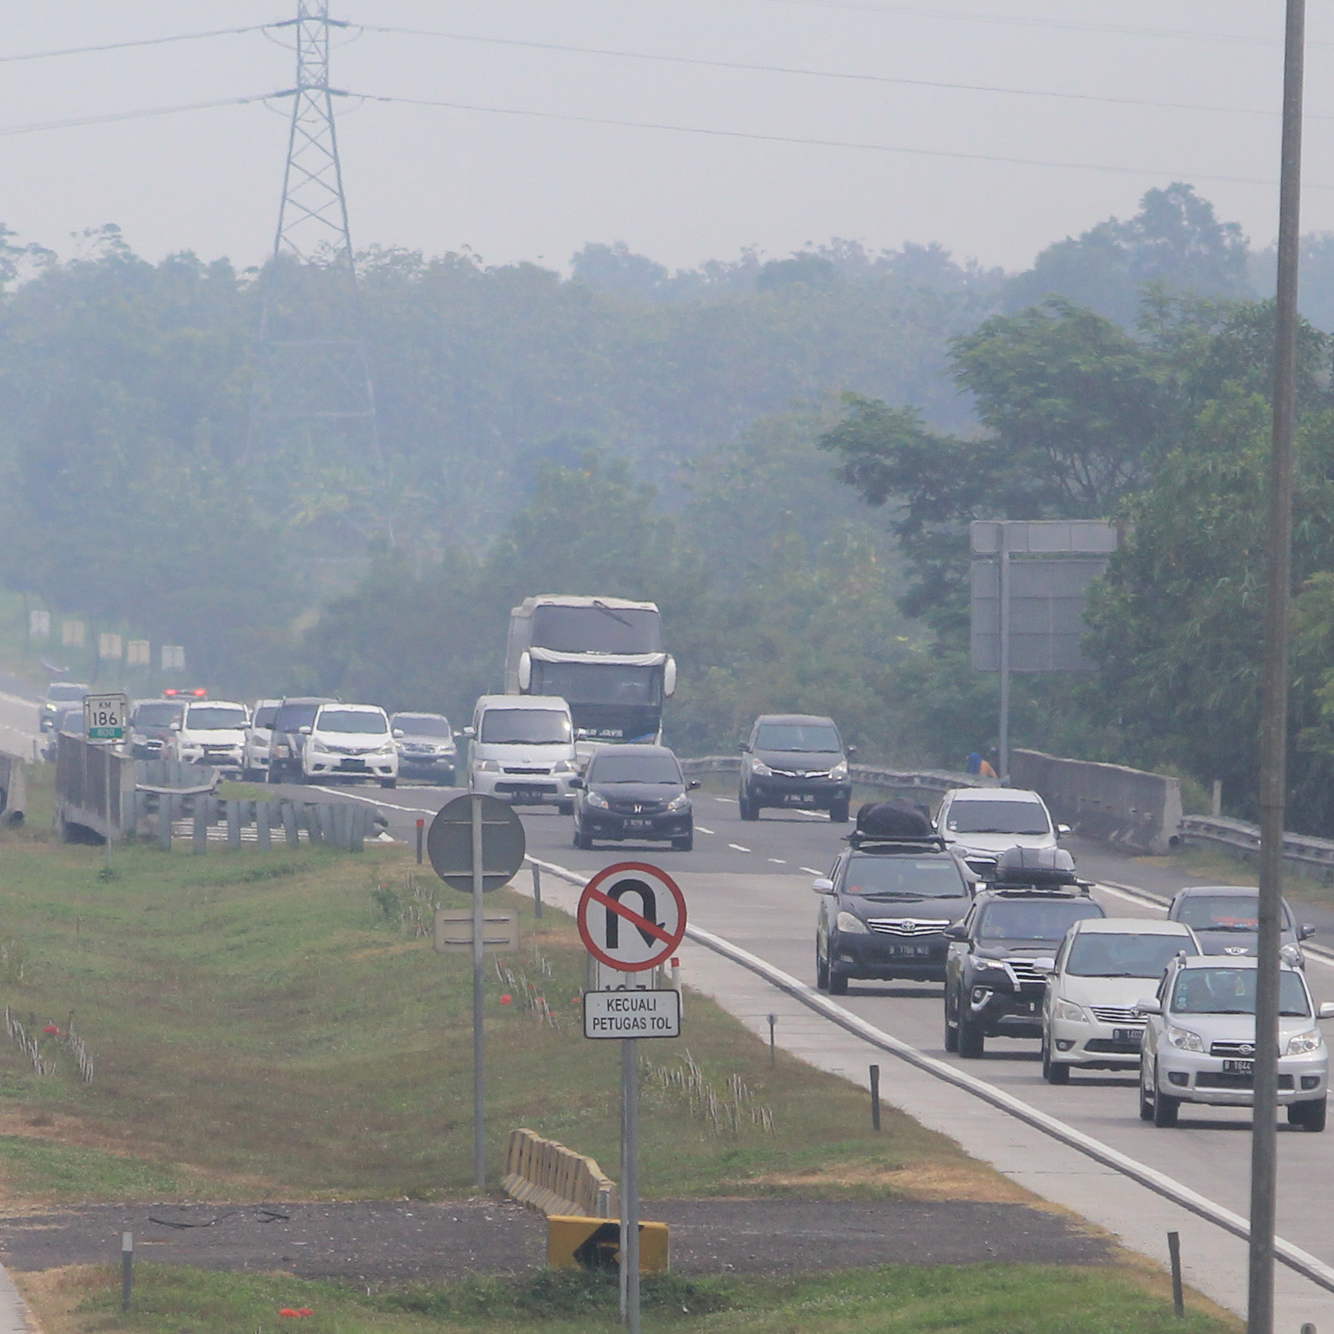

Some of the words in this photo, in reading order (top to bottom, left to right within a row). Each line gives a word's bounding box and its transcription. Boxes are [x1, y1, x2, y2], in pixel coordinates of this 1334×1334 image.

[93, 711, 118, 726] 186
[607, 998, 657, 1012] KECUALI
[593, 1017, 647, 1030] PETUGAS
[650, 1017, 673, 1030] TOL
